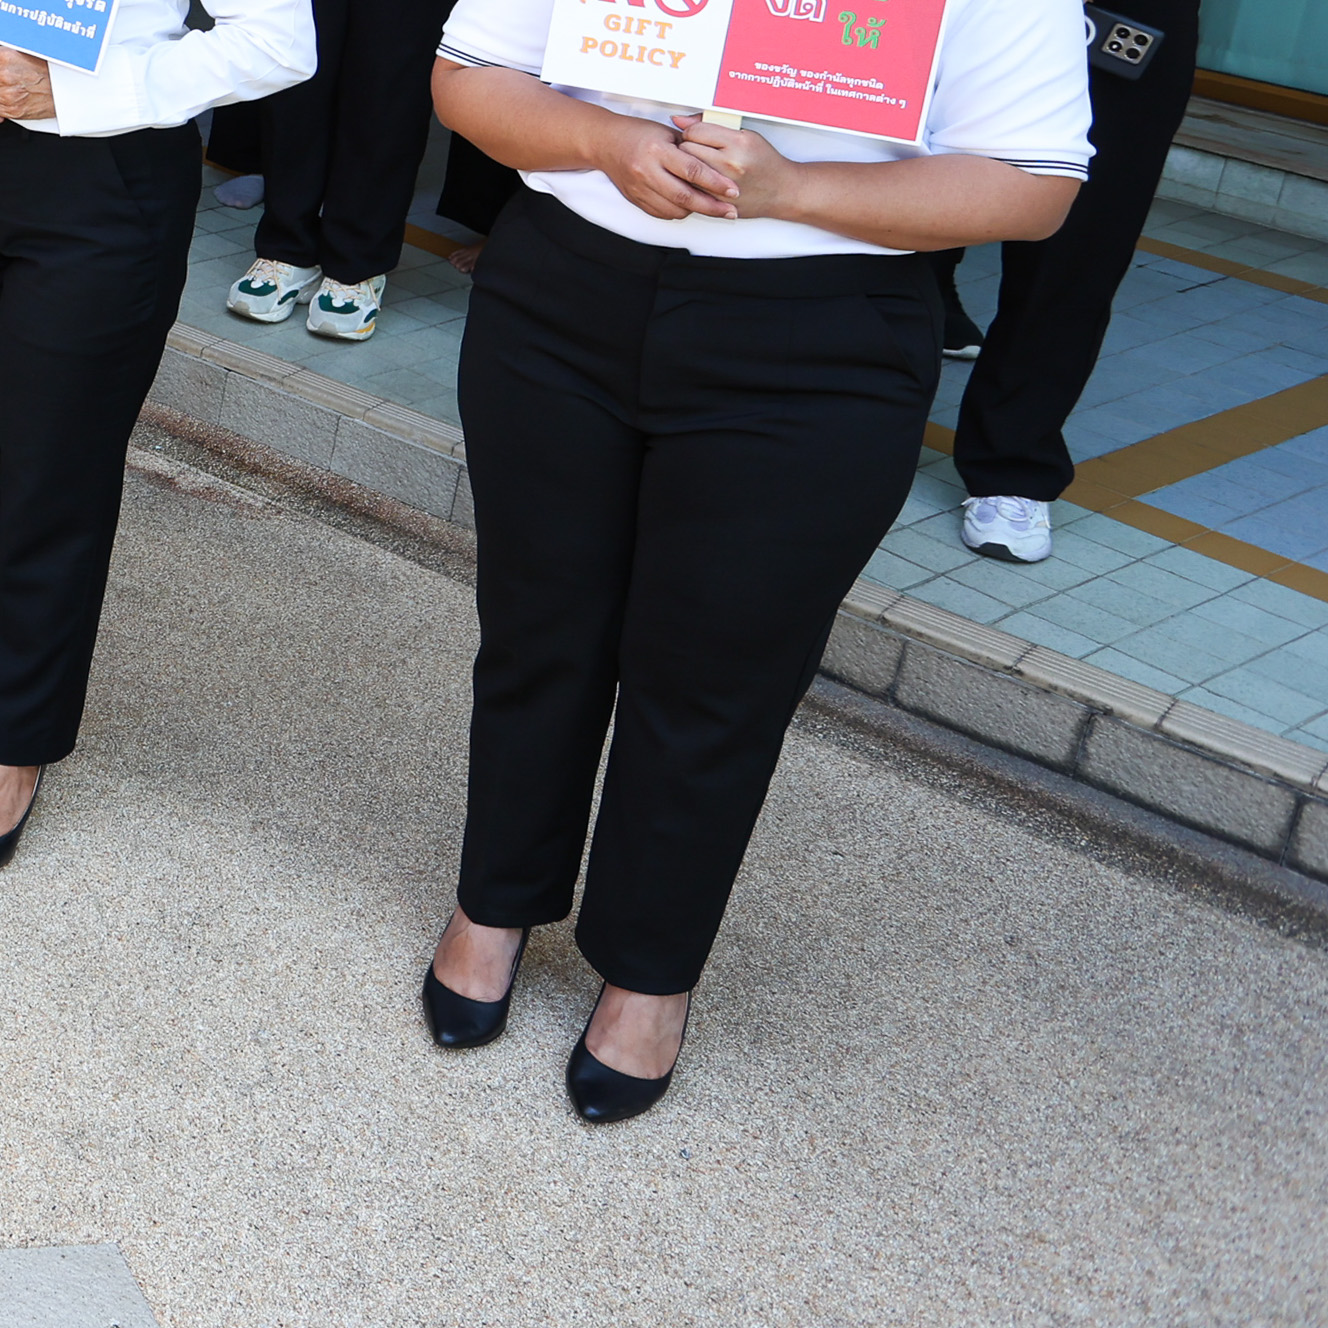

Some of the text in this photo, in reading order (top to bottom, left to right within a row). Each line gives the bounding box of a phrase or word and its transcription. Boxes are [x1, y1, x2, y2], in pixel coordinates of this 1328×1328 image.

[603, 13, 673, 40] GIFT
[838, 11, 884, 50] ให้
[579, 36, 687, 69] POLICY
[729, 70, 824, 92] จากการปฏิบัติหน้าที่
[754, 61, 885, 90] ของขวัญ ของกำนัลทุกชนิด
